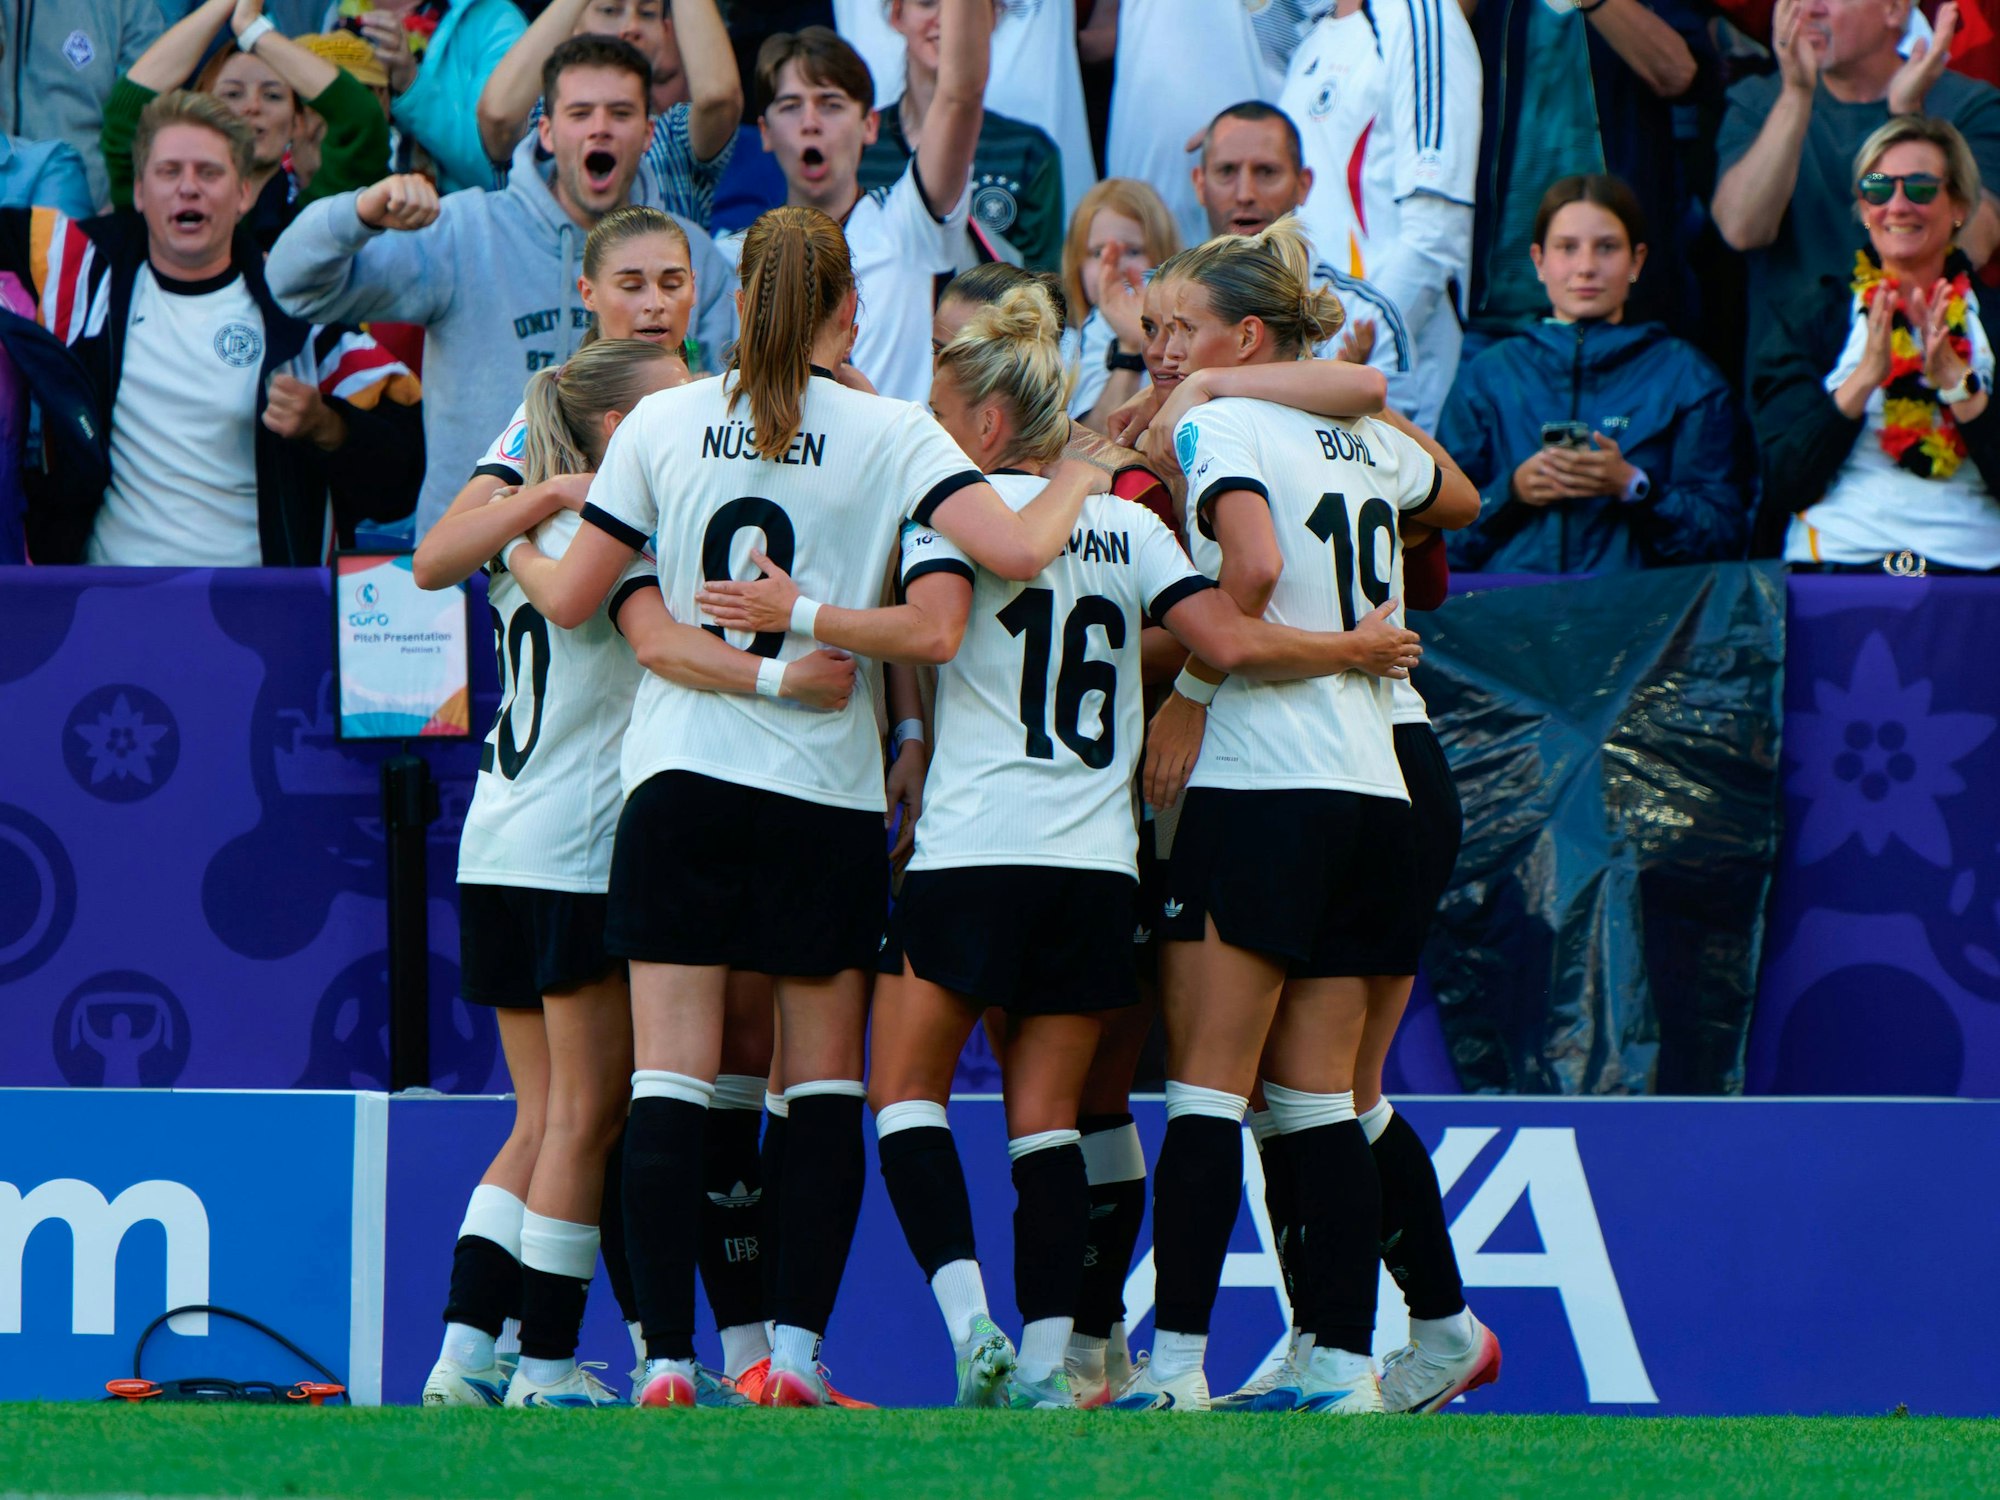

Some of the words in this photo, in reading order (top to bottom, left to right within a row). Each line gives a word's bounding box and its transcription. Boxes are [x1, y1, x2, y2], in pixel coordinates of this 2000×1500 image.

[702, 420, 826, 467] NÜSEN
[1315, 427, 1377, 468] BÜHL
[353, 632, 380, 643] Pitch
[383, 631, 452, 642] Presentation
[995, 587, 1127, 770] 16
